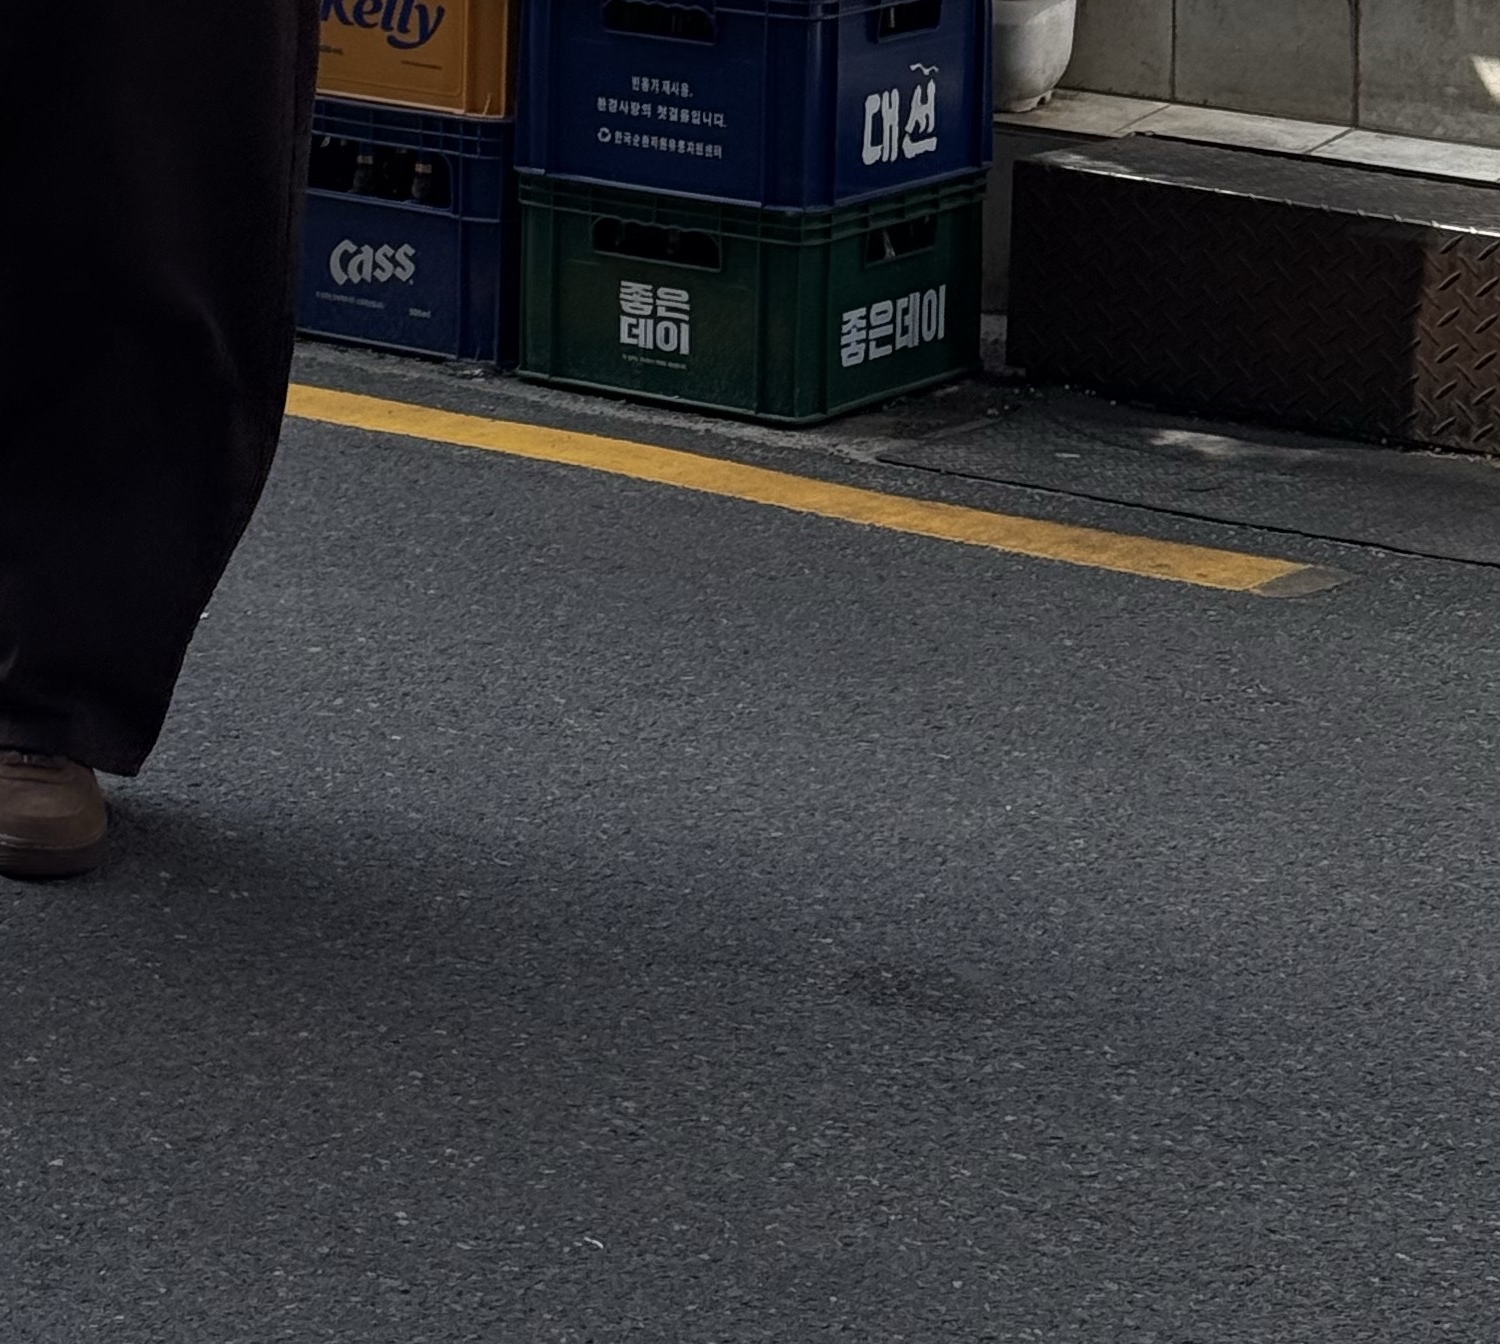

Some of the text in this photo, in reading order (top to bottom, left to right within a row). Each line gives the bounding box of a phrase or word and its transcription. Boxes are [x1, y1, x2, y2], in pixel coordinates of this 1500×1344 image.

[861, 78, 937, 166] 대선
[329, 238, 416, 286] Cass
[619, 280, 690, 322] 좋은
[619, 314, 690, 356] 데이
[840, 283, 947, 368] 좋은데이
